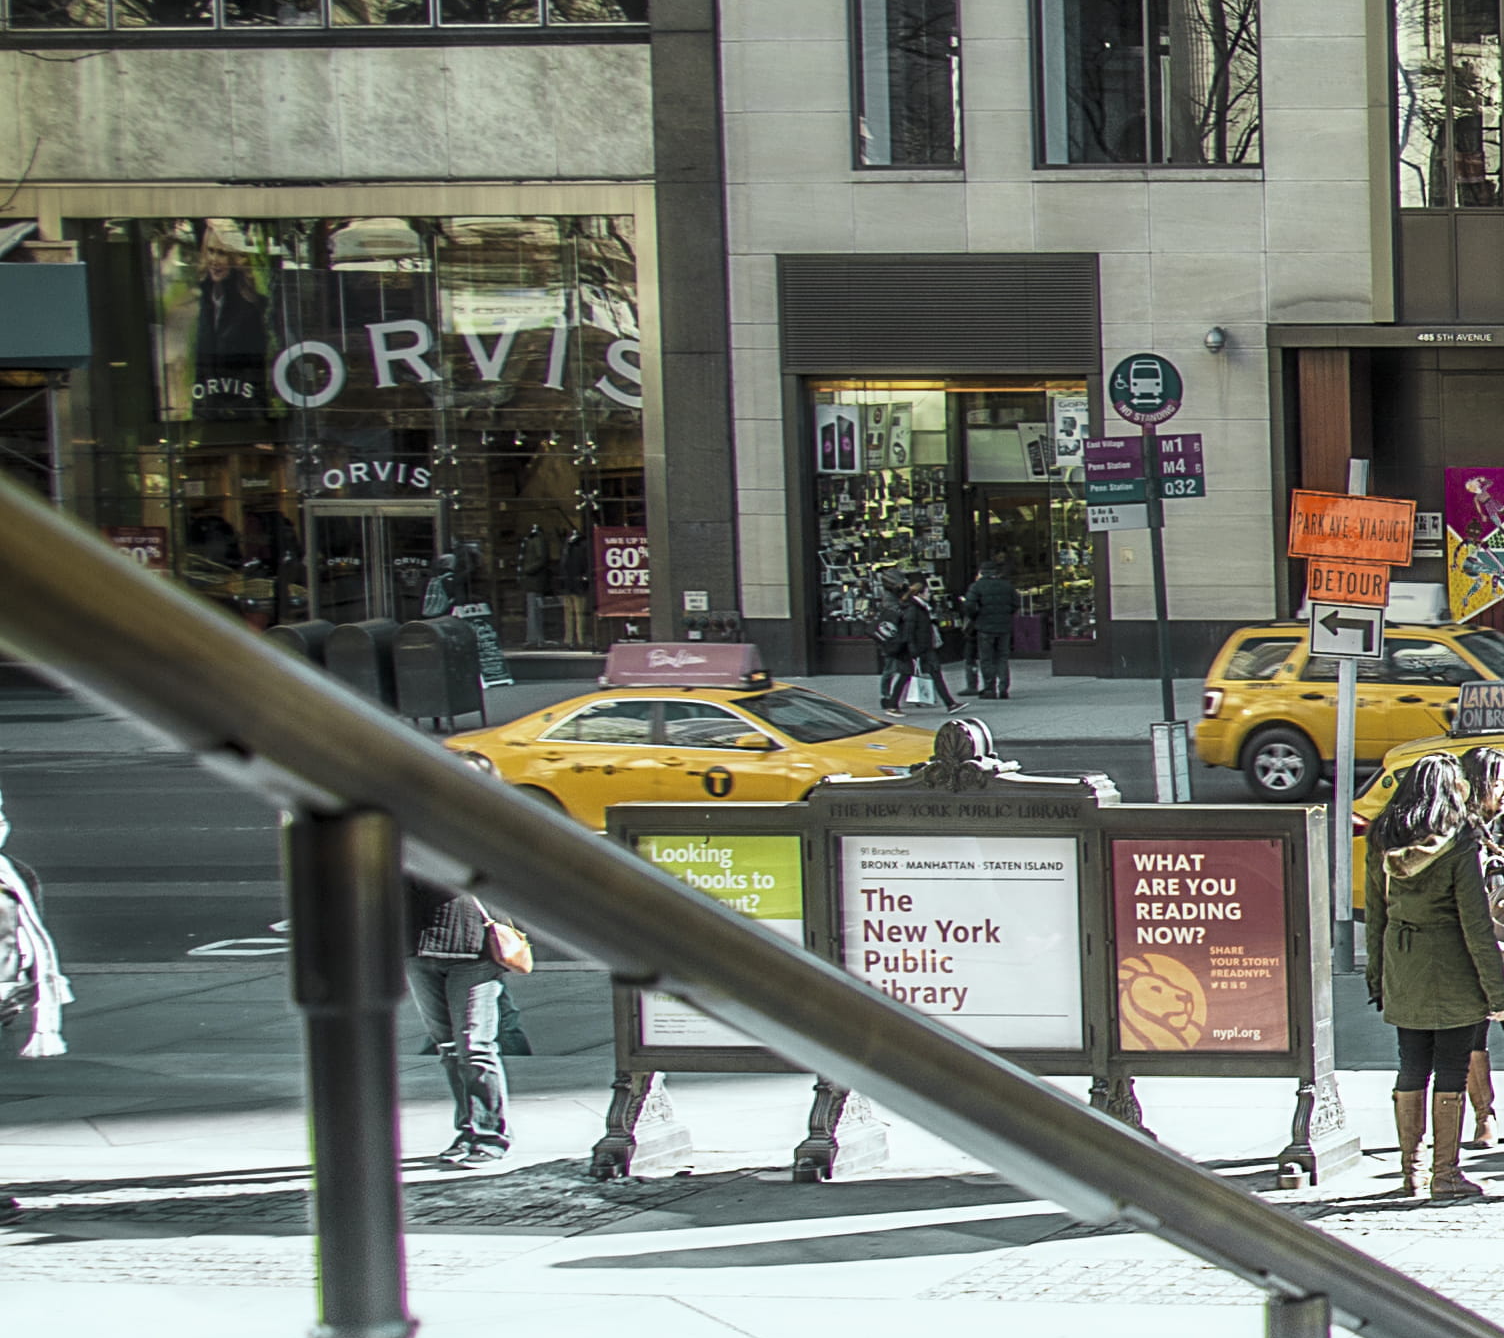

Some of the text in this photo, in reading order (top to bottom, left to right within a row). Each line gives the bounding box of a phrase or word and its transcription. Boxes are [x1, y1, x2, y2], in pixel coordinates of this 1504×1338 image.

[1418, 333, 1492, 342] 485 5TH AVENUE
[273, 319, 642, 410] ORVIS
[192, 376, 255, 399] ORVIS
[1119, 404, 1176, 422] NO STANDING
[1103, 440, 1125, 449] Village
[1161, 437, 1184, 453] M1
[323, 460, 432, 489] ORVIS
[1088, 461, 1131, 471] Penn Station
[1163, 458, 1186, 474] M4
[1109, 483, 1133, 491] Station
[1165, 479, 1197, 495] Q32
[1101, 516, 1110, 524] 41
[1111, 515, 1119, 523] St
[1296, 511, 1406, 544] PARK VIADUCT
[606, 570, 650, 587] OFF
[1312, 568, 1383, 597] DETOUR
[1462, 710, 1482, 728] ON
[710, 772, 728, 794] T
[830, 804, 1081, 819] THE NEW YORK PUBLIC LIBRARY
[651, 844, 733, 868] Looking
[872, 847, 910, 856] Branches
[861, 861, 1064, 871] BRONX MANHATTAN STATEN ISLAND
[1133, 854, 1205, 872] WHAT
[687, 869, 775, 889] books to
[1134, 878, 1236, 896] ARE YOU
[861, 887, 913, 912] The
[1136, 902, 1242, 920] READING
[864, 919, 1001, 943] New York
[1137, 926, 1206, 945] NOW?
[1209, 946, 1244, 955] SHARE
[864, 949, 954, 974] Public
[1210, 958, 1279, 967] YOUR STORY!
[1210, 969, 1272, 978] #READNYPL
[865, 979, 968, 1012] ibrary
[1213, 1027, 1261, 1041] nypl.org
